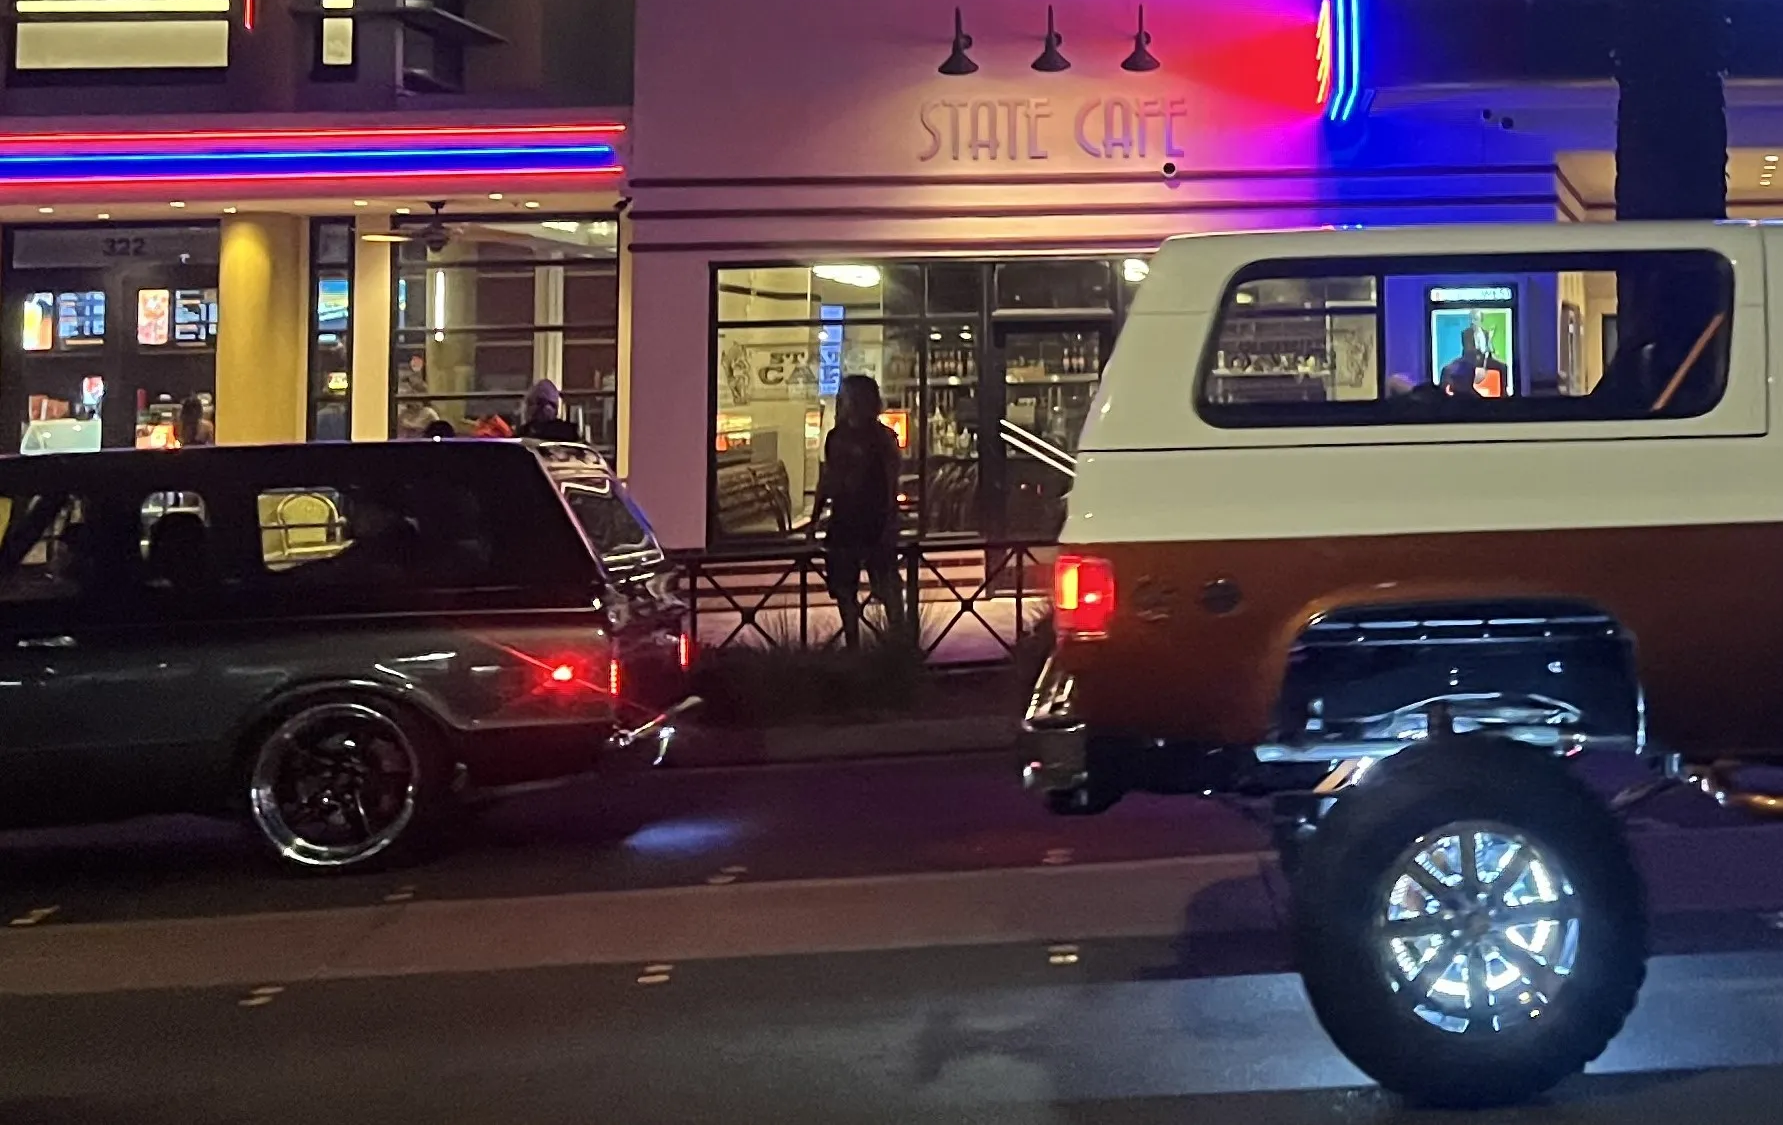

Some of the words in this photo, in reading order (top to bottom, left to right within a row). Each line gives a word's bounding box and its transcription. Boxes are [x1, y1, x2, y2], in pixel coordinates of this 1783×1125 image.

[917, 98, 1052, 162] STATE
[1073, 98, 1187, 159] CAFE
[103, 237, 145, 256] 322
